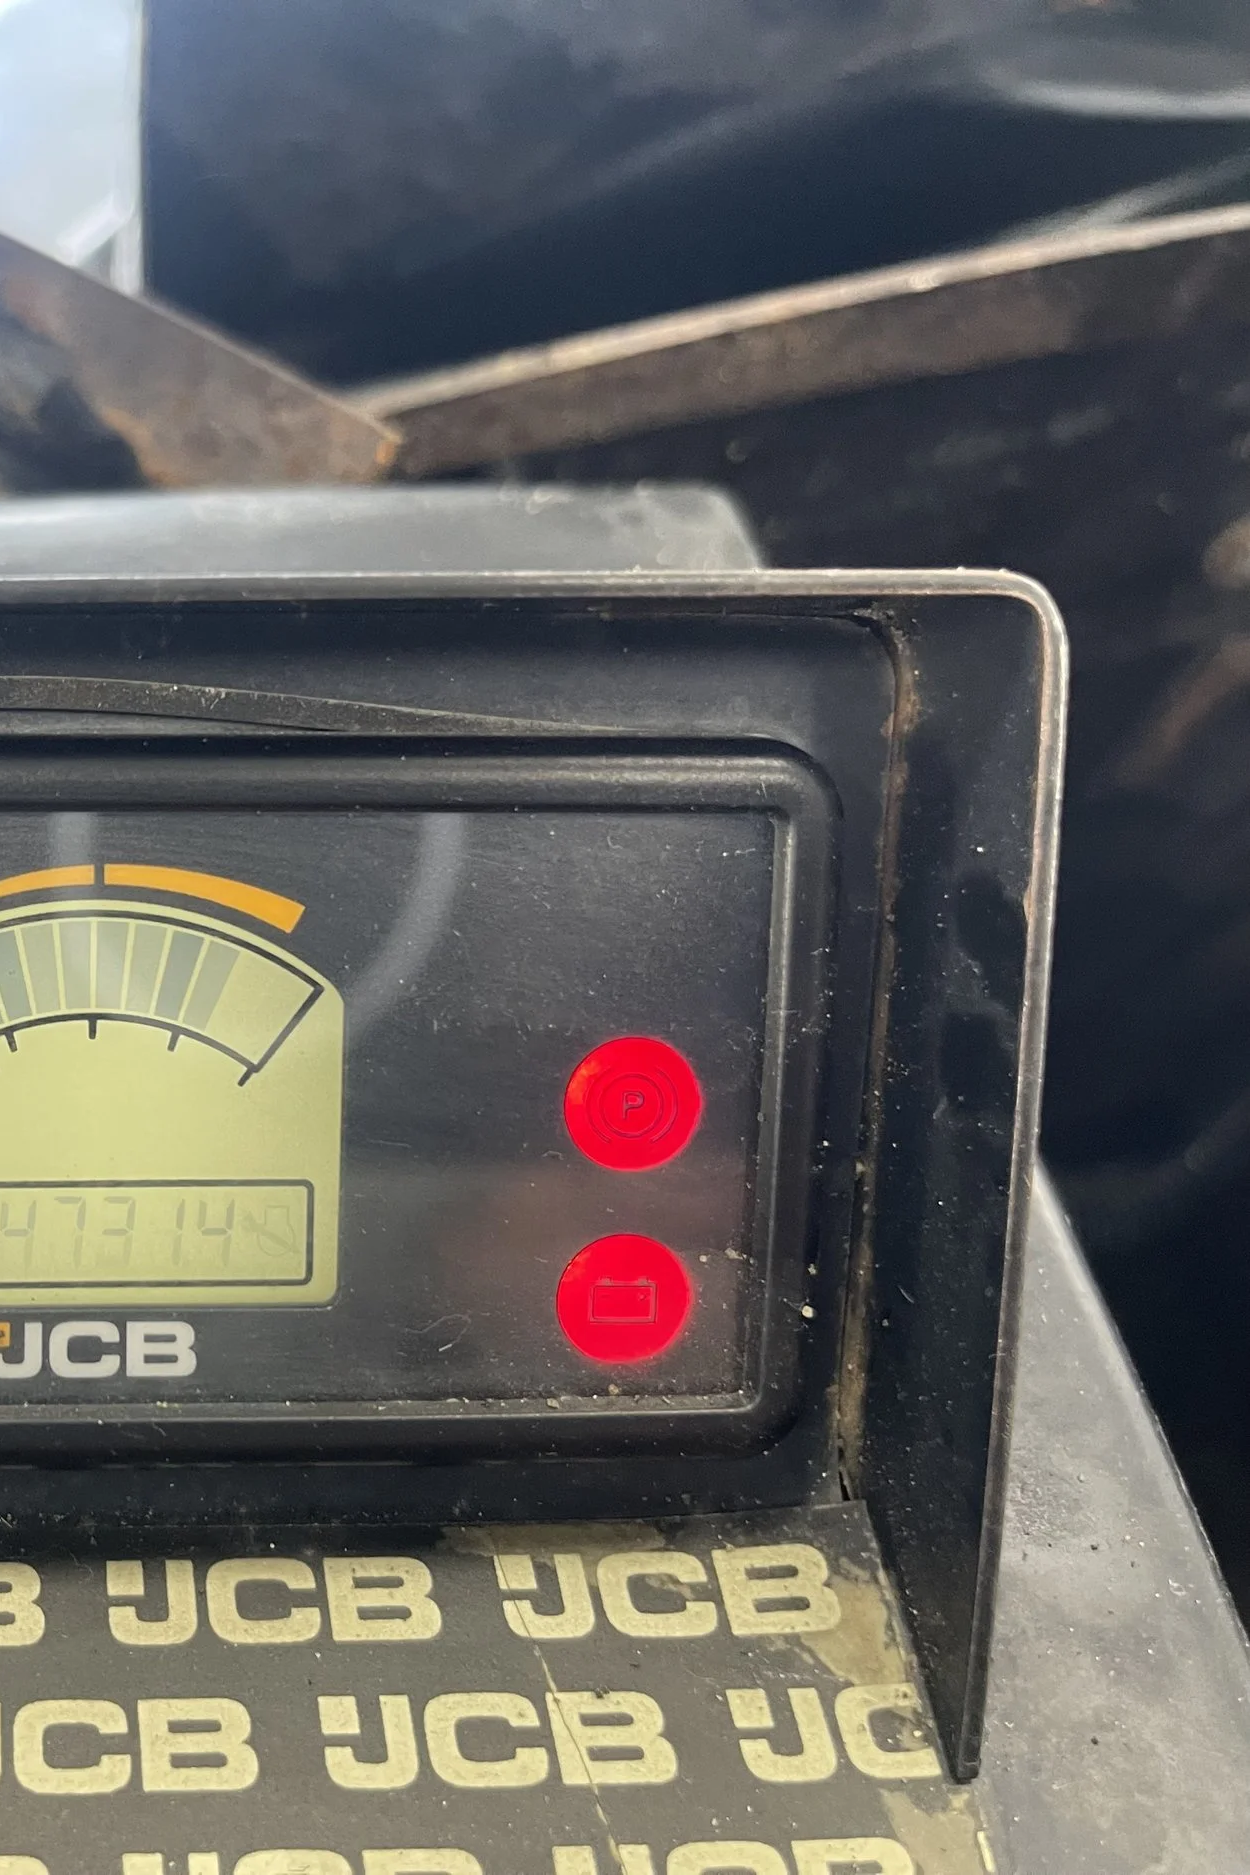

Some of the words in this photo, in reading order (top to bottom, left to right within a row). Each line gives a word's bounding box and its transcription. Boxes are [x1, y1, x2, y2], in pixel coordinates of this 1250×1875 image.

[106, 1557, 441, 1645] JCB
[494, 1543, 840, 1639] JCB
[318, 1691, 677, 1789] JCB
[725, 1683, 941, 1782] JC
